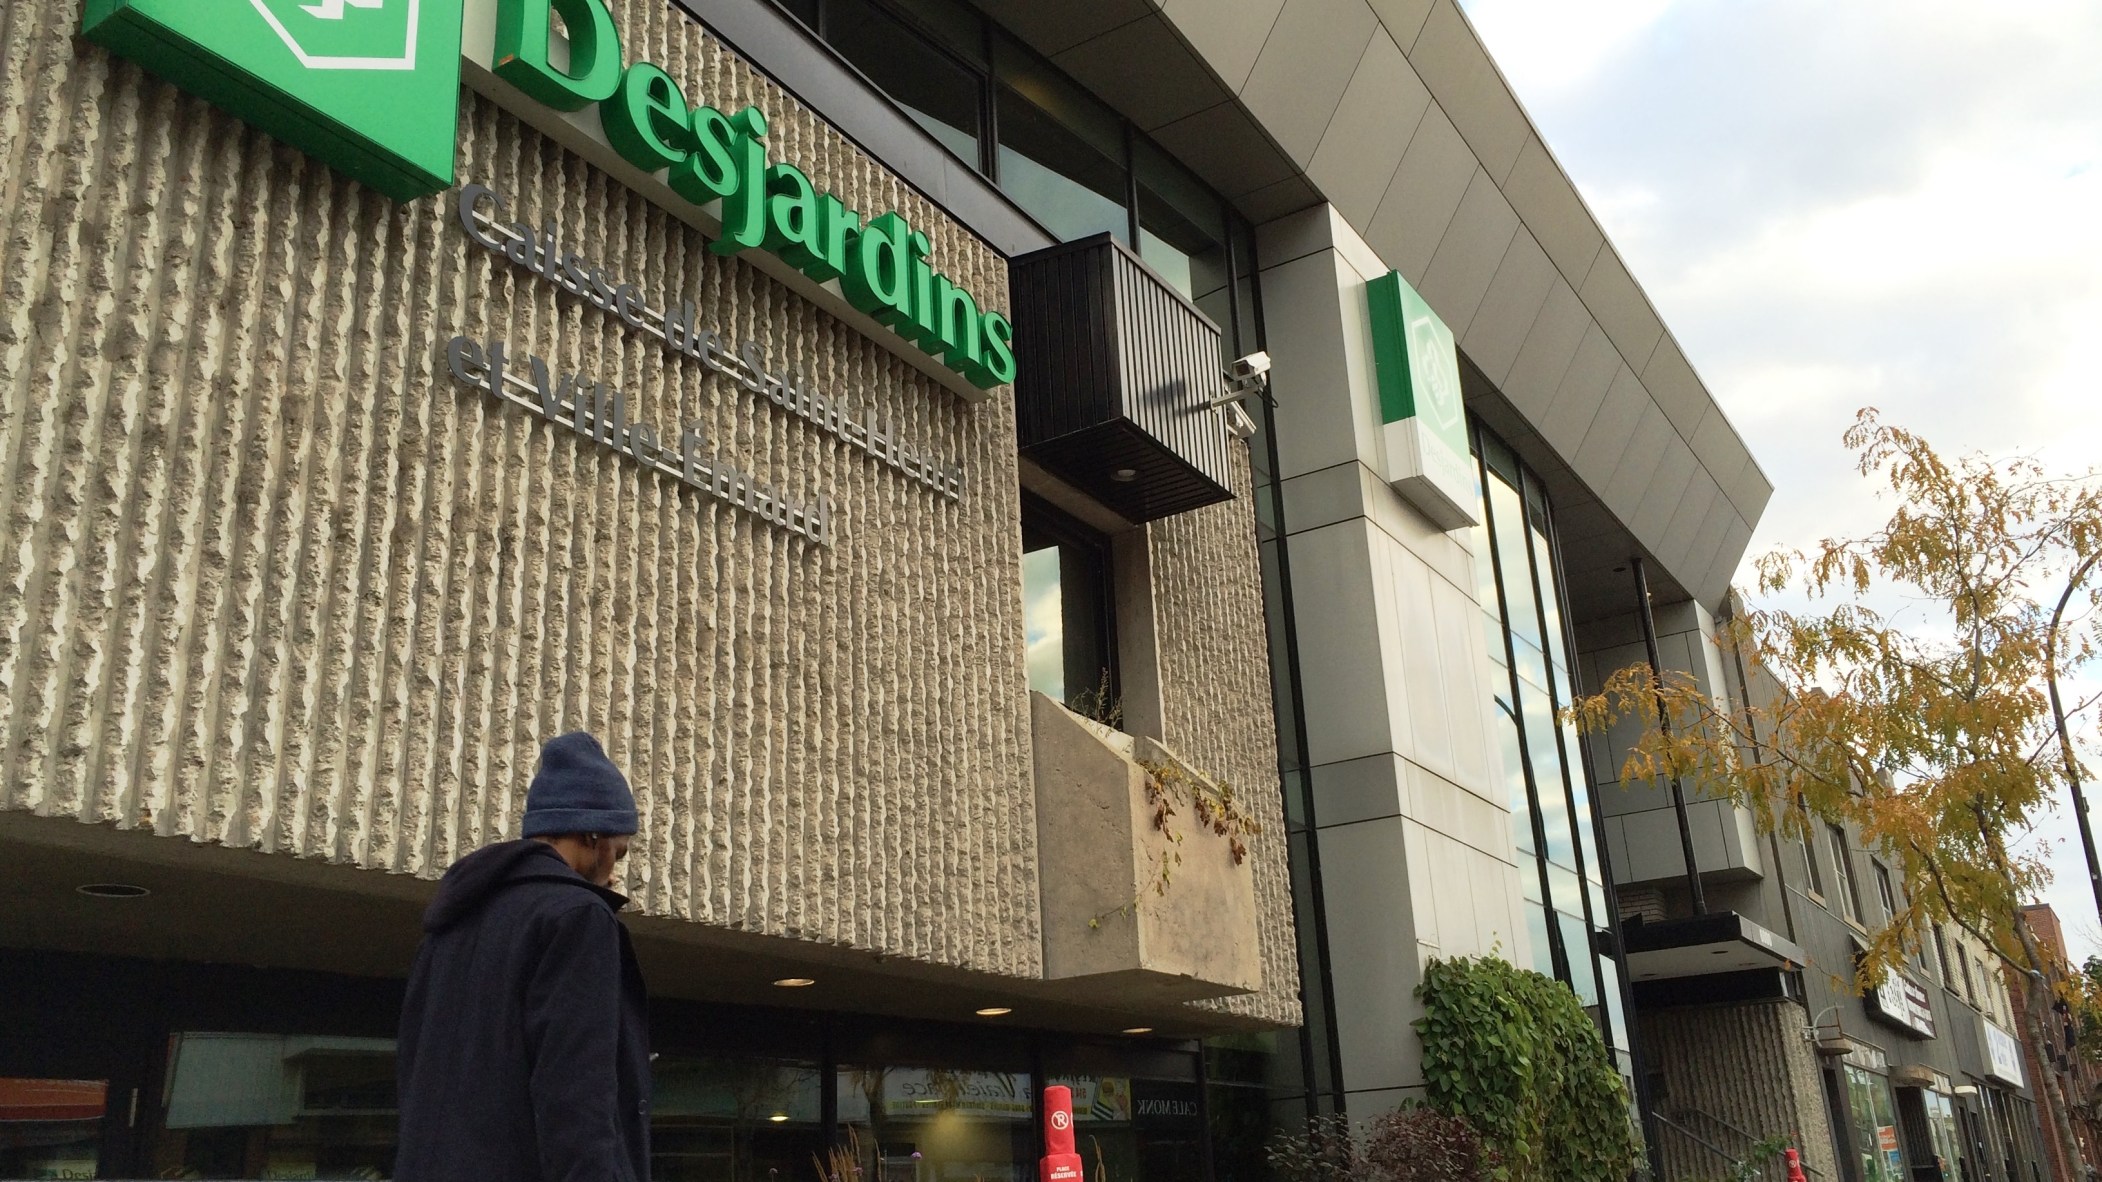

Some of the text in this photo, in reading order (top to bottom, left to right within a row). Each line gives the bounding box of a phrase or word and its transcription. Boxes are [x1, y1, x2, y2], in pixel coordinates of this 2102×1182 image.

[459, 183, 966, 502] Caisse de Saint-Henri
[494, 0, 1017, 388] Desjardins
[448, 334, 832, 547] et Ville-Émard
